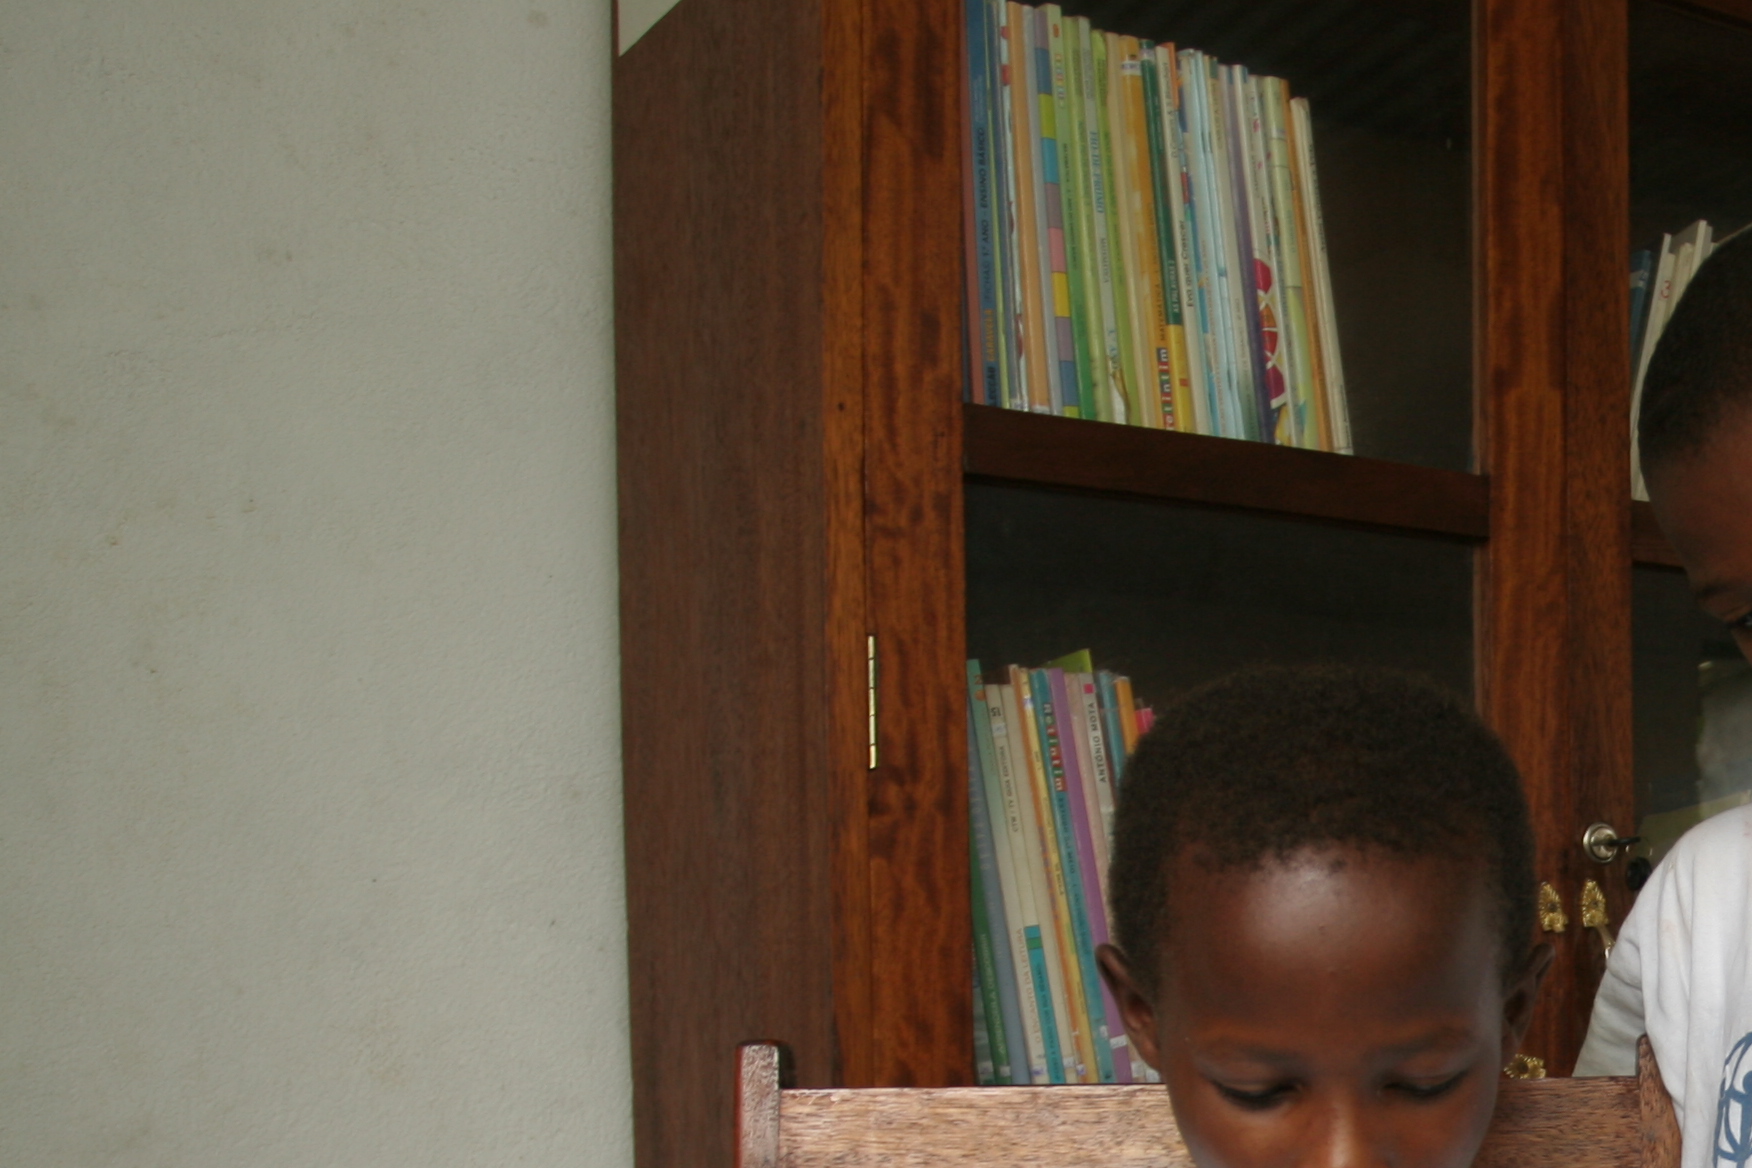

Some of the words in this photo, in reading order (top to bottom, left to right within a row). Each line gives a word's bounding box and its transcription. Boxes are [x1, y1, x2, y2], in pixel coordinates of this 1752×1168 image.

[976, 126, 985, 165] BÁSICO
[978, 167, 987, 208] ENSINO
[981, 219, 989, 243] ANO
[1176, 219, 1190, 260] Crescer
[1182, 262, 1193, 286] quer
[1184, 288, 1194, 307] Eva
[983, 309, 995, 361] CARAVELA
[1086, 701, 1098, 731] MOTA
[998, 745, 1009, 777] EDITORA
[1041, 702, 1066, 791] Retintim
[1090, 735, 1106, 783] ANTÓNIO
[1004, 778, 1012, 796] GUIA
[1014, 927, 1028, 968] LEITURA
[1022, 970, 1031, 985] DA
[1025, 987, 1040, 1033] ENCANTO
